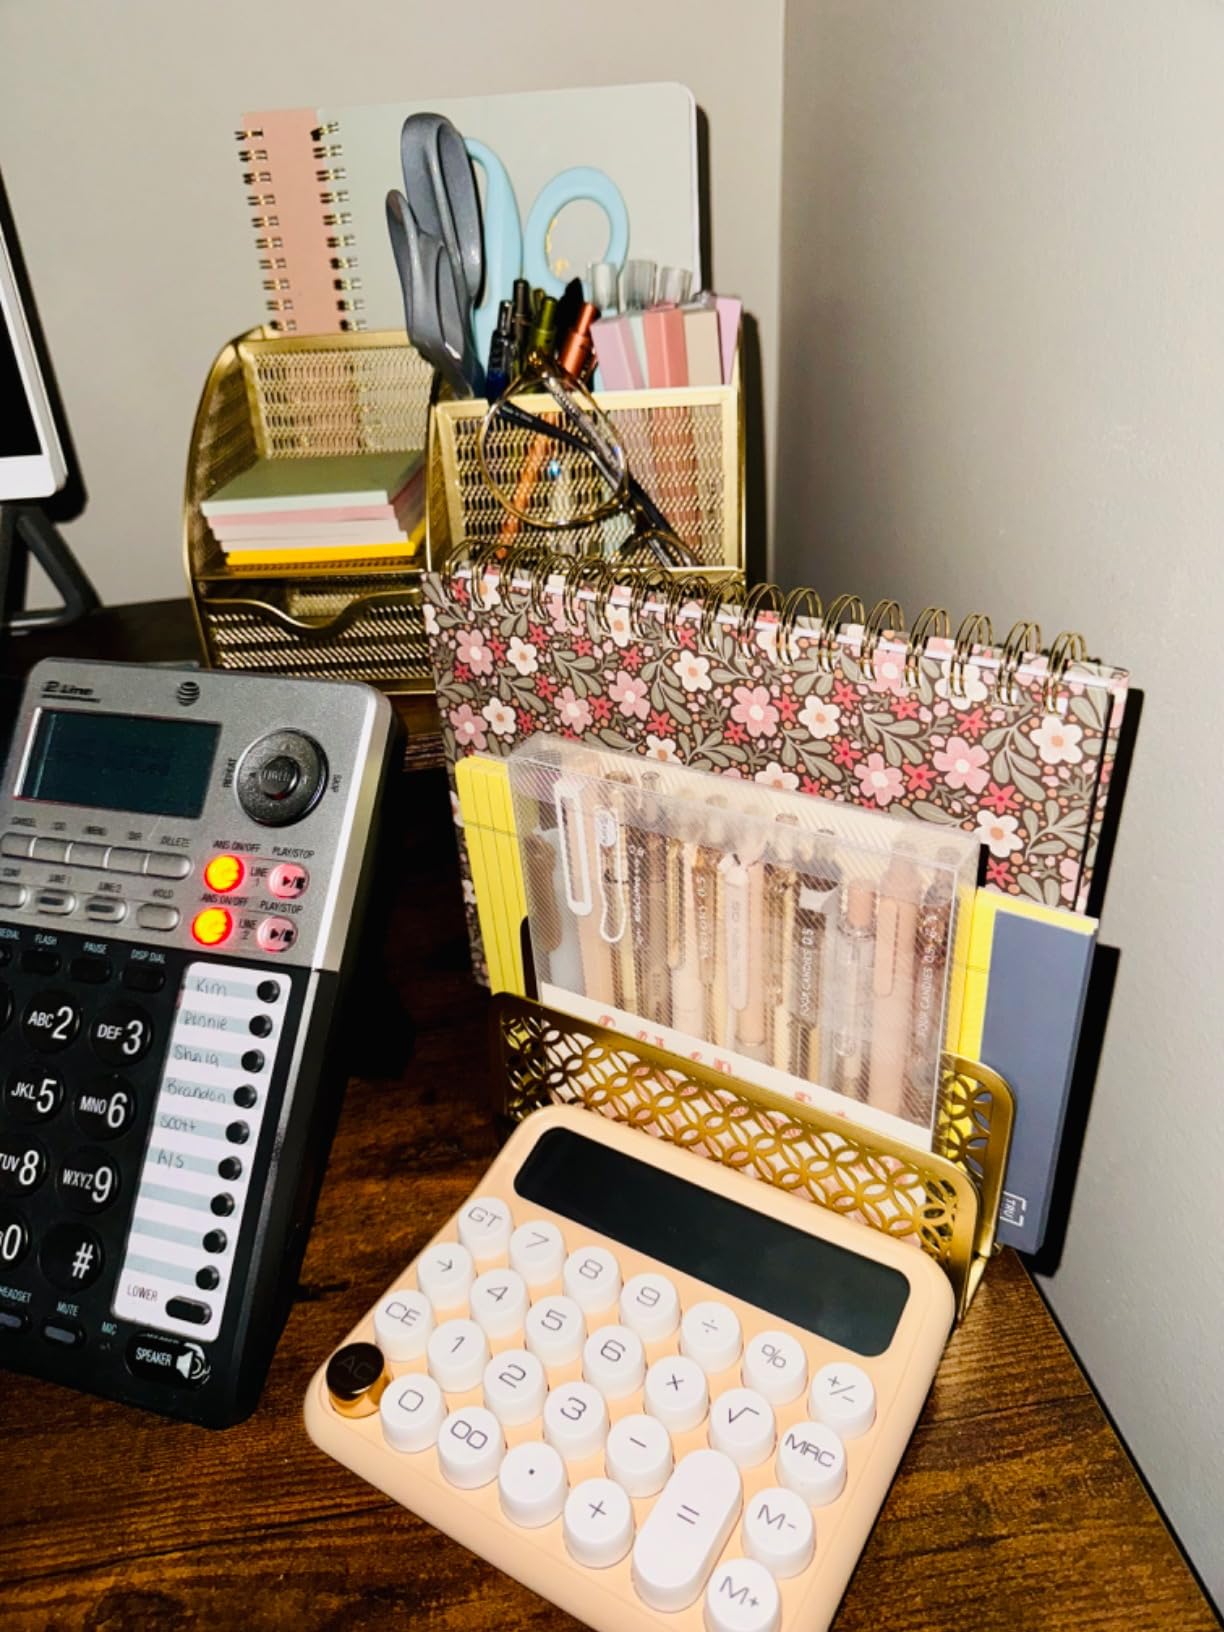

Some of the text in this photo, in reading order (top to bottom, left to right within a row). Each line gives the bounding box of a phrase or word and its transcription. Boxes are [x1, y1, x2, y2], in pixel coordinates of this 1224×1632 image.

[272, 846, 315, 859] PLAY/STOP
[250, 866, 269, 878] LINE
[238, 919, 258, 930] LINE
[35, 934, 57, 945] FLASH
[83, 941, 109, 955] PAUSE
[196, 978, 227, 997] Kim
[27, 1005, 74, 1040] ABC 2
[97, 1019, 144, 1055] DEF 3
[11, 1078, 57, 1113] JKL 5
[80, 1092, 128, 1128] MNO 6
[18, 1150, 40, 1186] 8
[62, 1166, 114, 1203] WXYZ 9
[467, 1206, 503, 1227] GT
[2, 1223, 22, 1261] 0
[525, 1231, 551, 1249] 7
[72, 1241, 94, 1280] #
[579, 1259, 603, 1280] 8
[126, 1284, 159, 1302] LOWER
[486, 1285, 509, 1302] 4
[636, 1286, 661, 1308] 9
[56, 1301, 80, 1317] MUTE
[385, 1301, 422, 1327] CE
[540, 1310, 568, 1332] 5
[451, 1335, 466, 1354] 1
[600, 1339, 627, 1363] 6
[760, 1343, 787, 1369] %
[135, 1348, 173, 1368] SPEAKER
[498, 1363, 527, 1389] 2
[560, 1396, 588, 1422] 3
[784, 1433, 836, 1469] MRC
[757, 1503, 798, 1532] M-
[719, 1575, 761, 1608] M+
